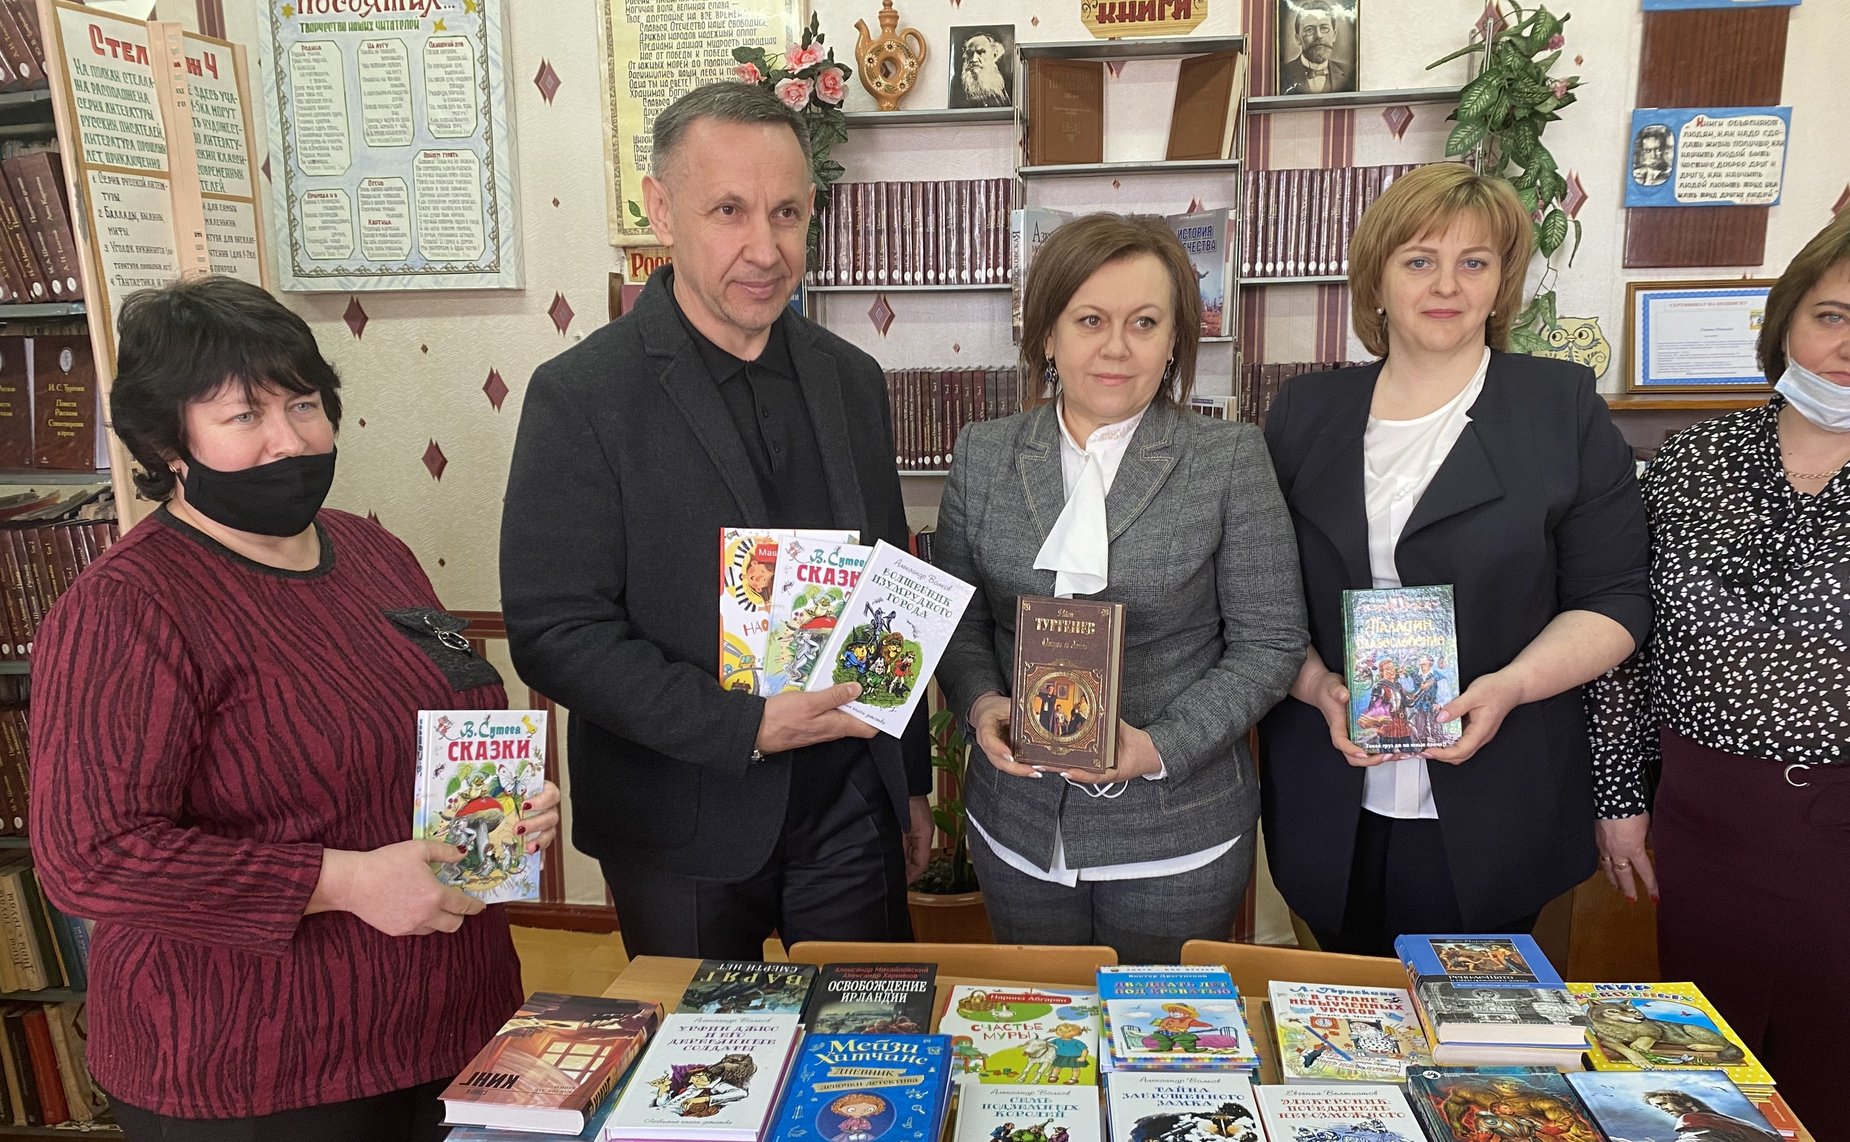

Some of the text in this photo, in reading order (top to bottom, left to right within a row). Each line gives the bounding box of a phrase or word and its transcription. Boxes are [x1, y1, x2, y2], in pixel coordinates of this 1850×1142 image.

[1177, 225, 1213, 240] ИСТОРИЯ
[881, 567, 953, 608] ВОЛШЕБНИК
[871, 573, 954, 619] ИЗУМРУДНОГО
[886, 593, 929, 622] ГОРОДА
[1034, 617, 1097, 636] ТУРГЕНЕВ
[448, 738, 531, 762] СКАЗКИ
[717, 962, 799, 974] СМЕРТИ НЕТ
[699, 971, 803, 986] ВАРЯГ
[828, 980, 928, 994] ОСВОБОЖДЕНИЕ
[1115, 988, 1233, 996] ПОД КРОВАТЬЮ
[1593, 982, 1654, 992] МИР
[839, 991, 908, 1004] ИРЛАНДИИ
[1325, 995, 1380, 1004] СТРАНЕ
[1289, 998, 1406, 1011] НЕВЫУЧЕННЫХ
[1320, 1007, 1379, 1015] УРОКОВ
[679, 1024, 780, 1033] УРФИН ДЖЮС
[971, 1023, 1044, 1034] СЧАСТЬЕ
[667, 1038, 777, 1046] ДЕРЕВЯННЫЕ
[683, 1045, 757, 1053] СОЛДАТЫ
[828, 1039, 919, 1056] Мейзи
[813, 1052, 929, 1067] Хитчинс
[833, 1068, 895, 1078] ДНЕВНИК
[459, 1070, 521, 1090] КИНГ
[1154, 1085, 1209, 1094] ТАЙНА
[1009, 1096, 1053, 1104] СЕМЬ
[1121, 1092, 1246, 1101] ЗАБРОШЕННОГО
[982, 1103, 1080, 1111] ПОДЗЕМНЫХ
[1157, 1099, 1213, 1108] ЗАМКА
[1285, 1105, 1390, 1113] ПОБЕДИТЕЛЬ
[995, 1110, 1066, 1119] КОРОЛЕЙ
[1278, 1111, 1407, 1120] НЕВОЗМОЖНОГО
